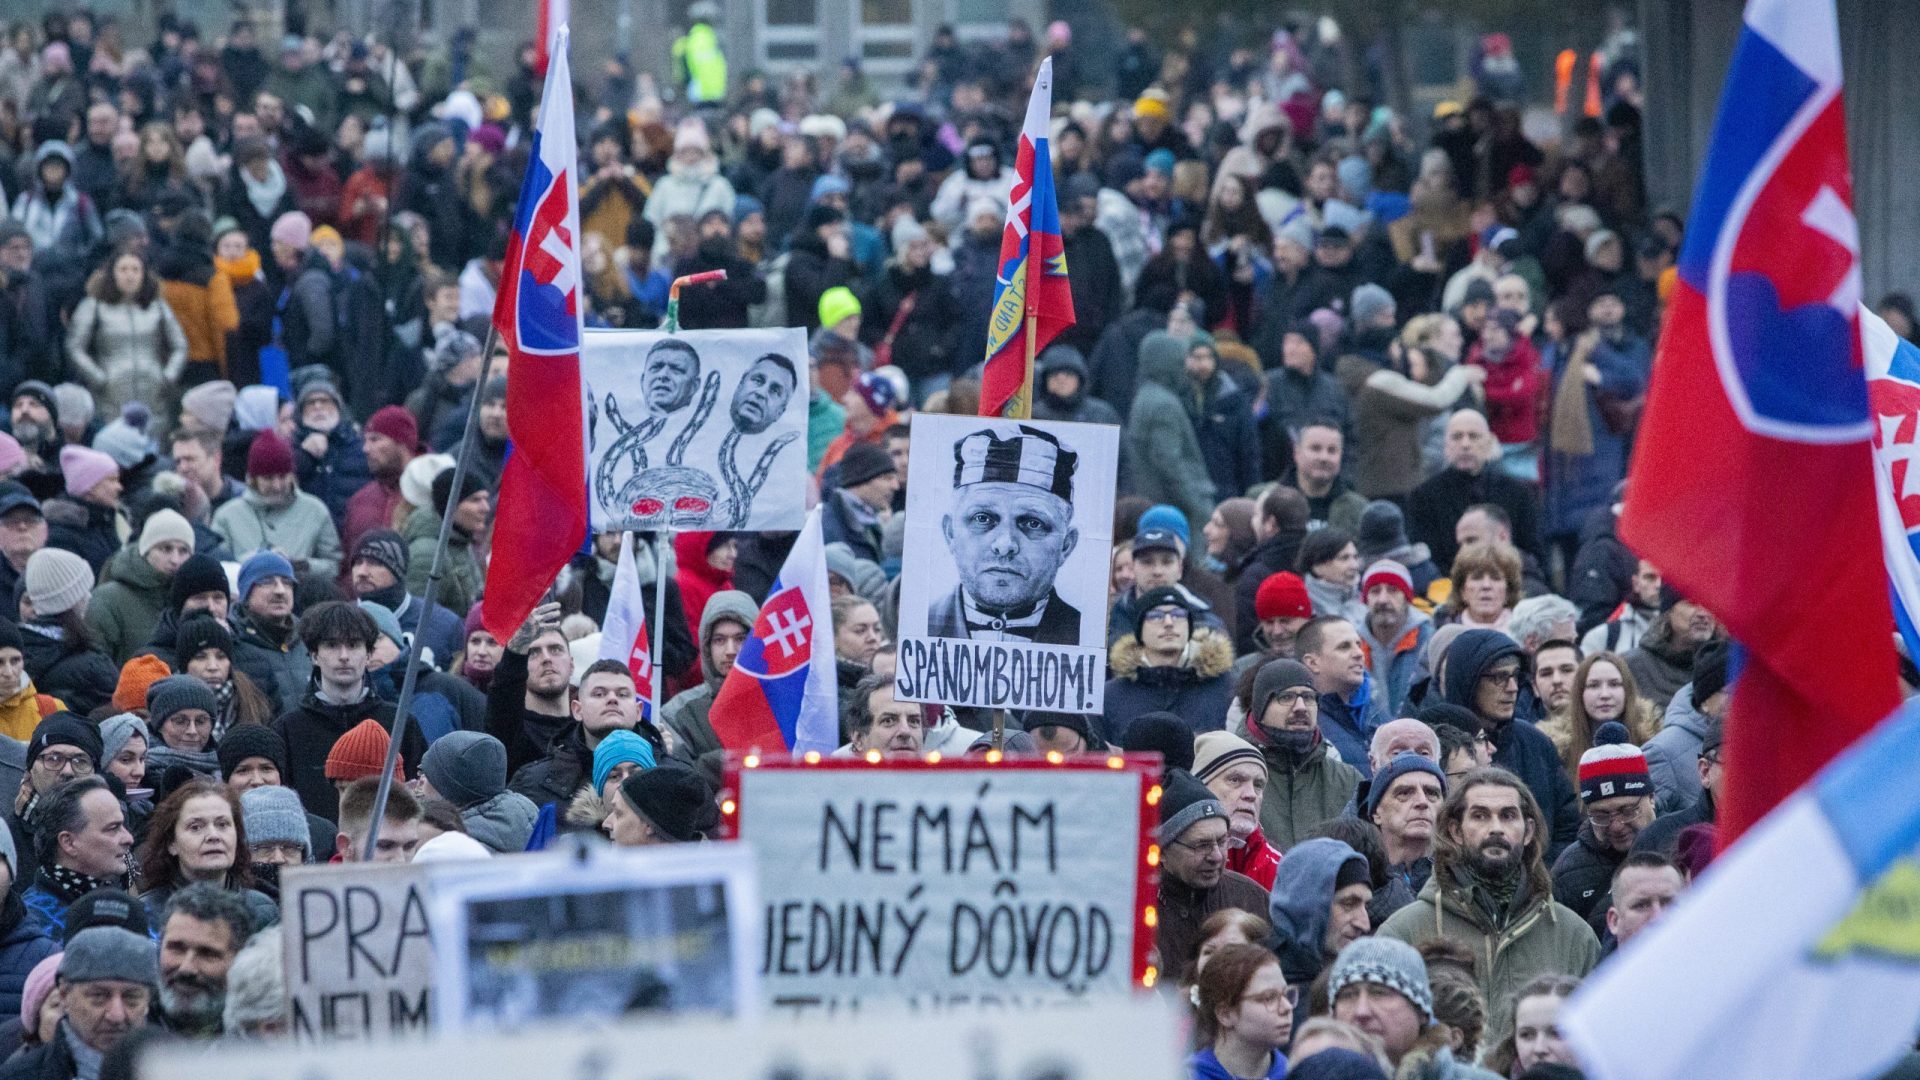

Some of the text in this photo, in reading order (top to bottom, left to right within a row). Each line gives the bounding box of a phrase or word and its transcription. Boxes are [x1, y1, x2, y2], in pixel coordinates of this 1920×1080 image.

[897, 638, 1096, 710] SPÁNOMBOHOM!
[819, 779, 1057, 873] NEMÁM
[298, 882, 432, 983] PRA
[762, 883, 928, 977] JEDINÝ
[949, 880, 1112, 980] DÔVOD
